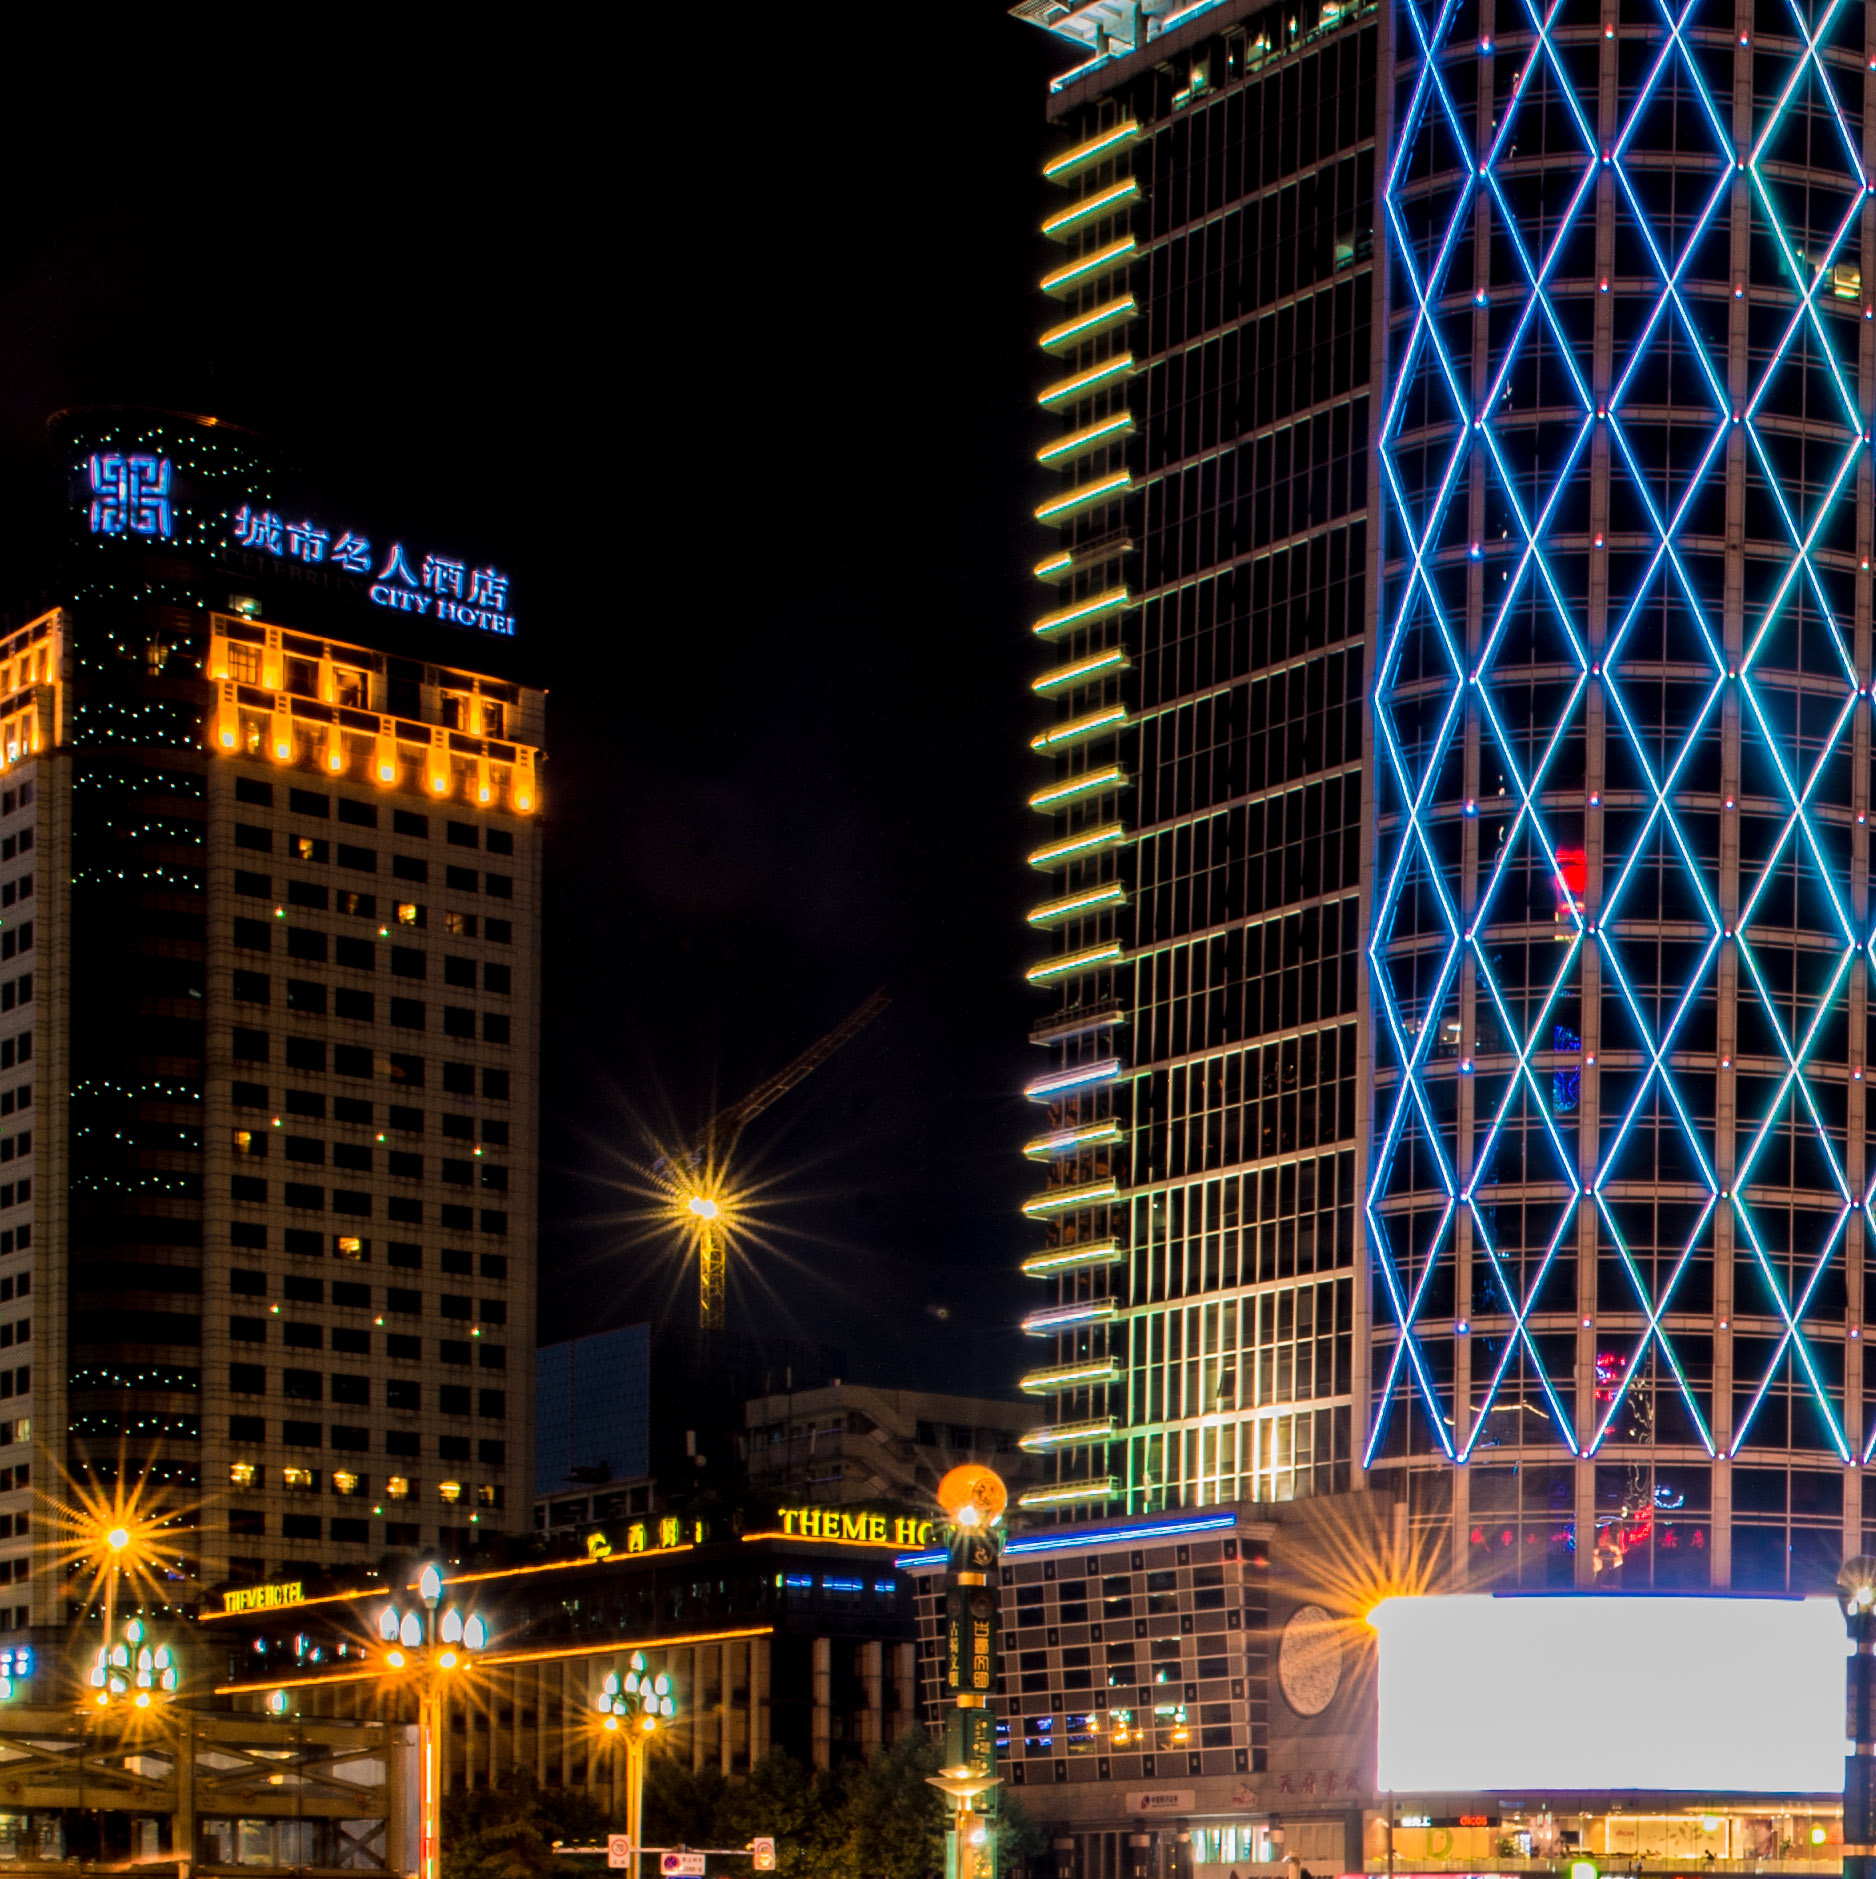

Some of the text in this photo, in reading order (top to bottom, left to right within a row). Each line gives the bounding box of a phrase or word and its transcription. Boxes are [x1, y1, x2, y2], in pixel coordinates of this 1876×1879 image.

[233, 502, 511, 612] 城市名人酒店
[367, 582, 432, 615] CITY
[778, 1507, 887, 1543] THEME
[1459, 1816, 1488, 1826] dicos
